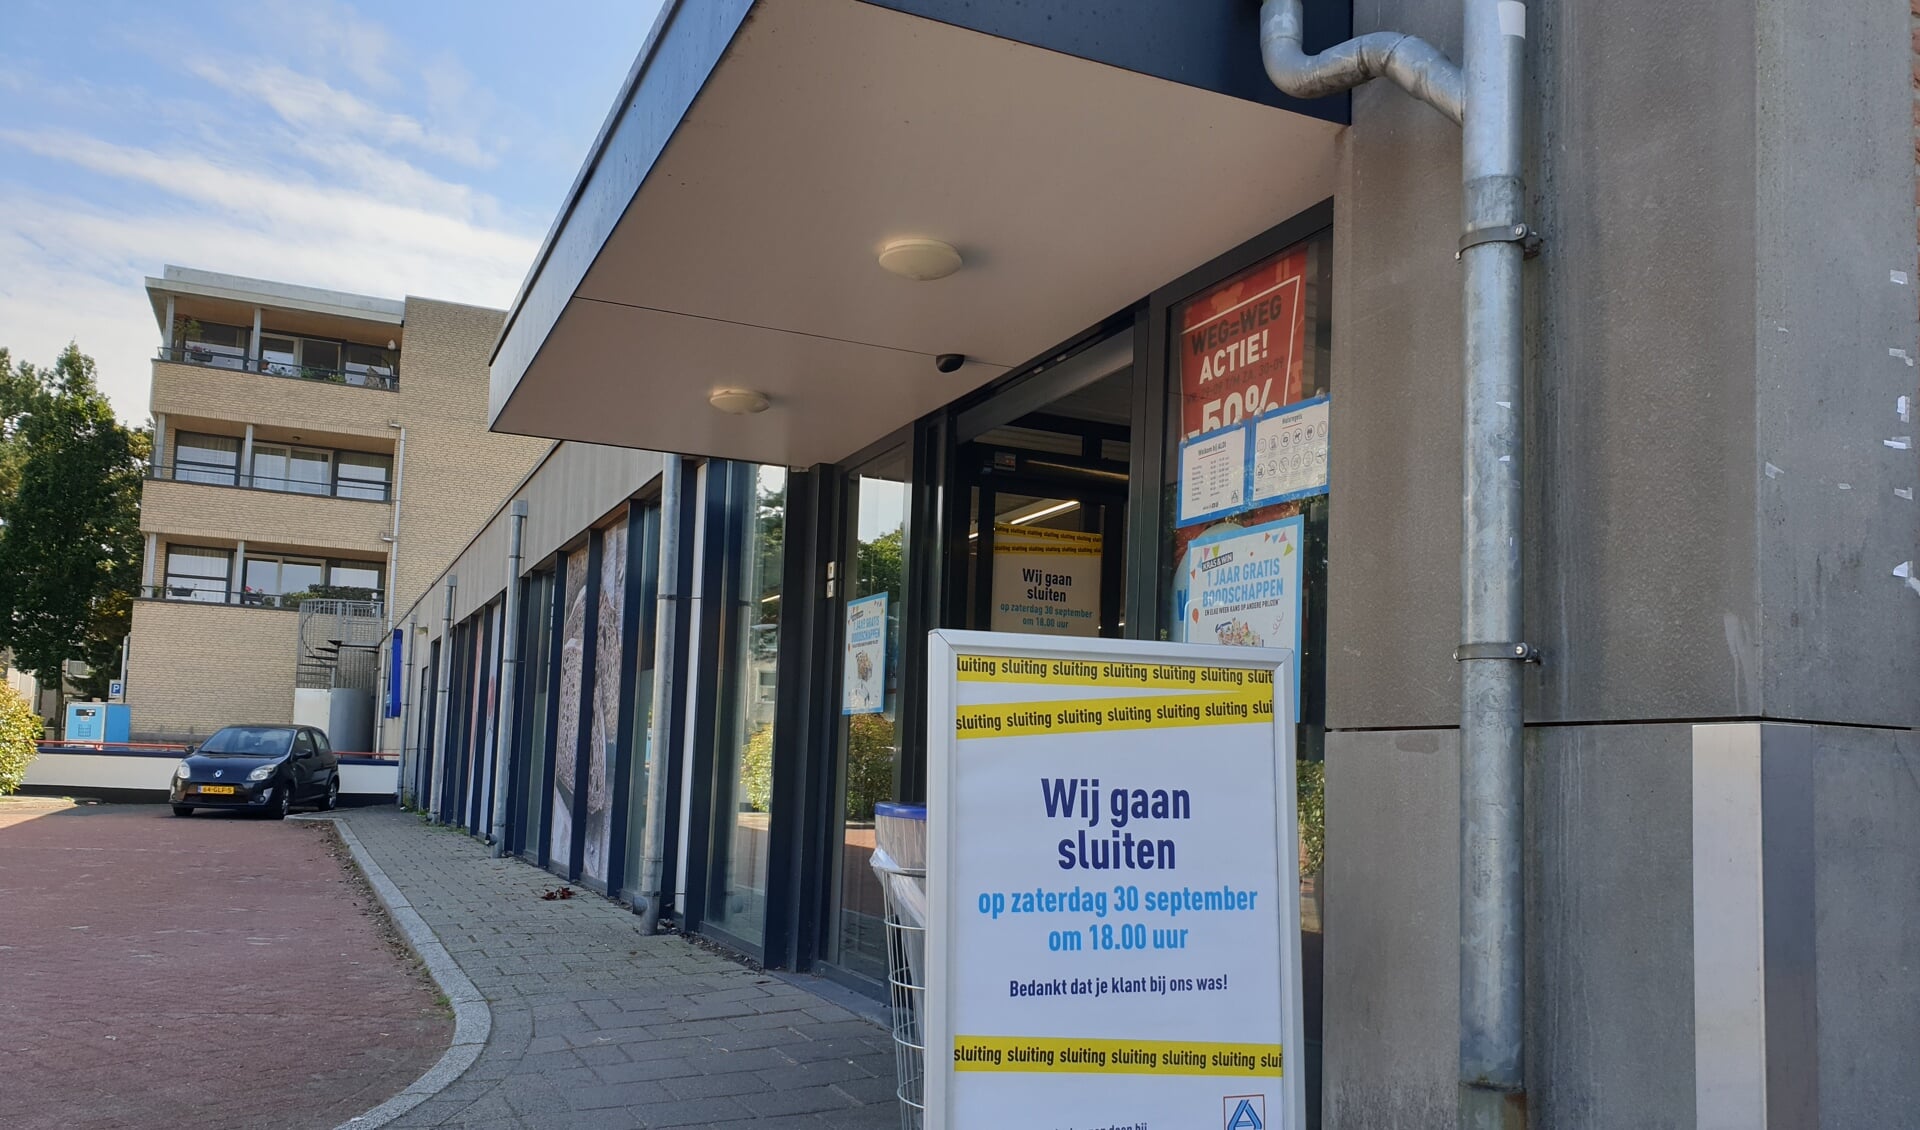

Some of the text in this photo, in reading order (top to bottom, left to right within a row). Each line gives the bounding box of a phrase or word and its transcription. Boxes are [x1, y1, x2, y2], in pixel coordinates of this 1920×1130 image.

[1191, 295, 1281, 355] WEG=WEG
[1199, 329, 1268, 385] ACTIE!
[1022, 568, 1072, 587] Wij gaan
[1207, 558, 1280, 587] 1 JAAR GRATIS
[1027, 586, 1066, 602] sluiten
[1202, 577, 1284, 607] BOODSCHAPPEN
[1000, 603, 1093, 618] op zaterdag 30 september
[1022, 617, 1068, 629] om 18.00 uur
[1002, 660, 1047, 678] sluiting
[1052, 661, 1097, 680] sluiting
[1103, 664, 1148, 682] sluiting
[1153, 666, 1196, 684] sluiting
[1201, 667, 1243, 686] sluiting
[1248, 669, 1273, 684] sluit
[956, 699, 1272, 731] sluiting sluiting sluiting sluiting sluiting sluiting slui
[1041, 778, 1191, 828] Wij gaan
[1058, 830, 1176, 870] sluiten
[978, 885, 1258, 920] op zaterdag 30 september
[1048, 923, 1189, 952] om 18.00 uur
[1009, 974, 1228, 997] Bedankt dat je klant bij ons was!
[954, 1045, 1282, 1070] sluiting sluiting sluiting sluiting sluiting sluiting slui
